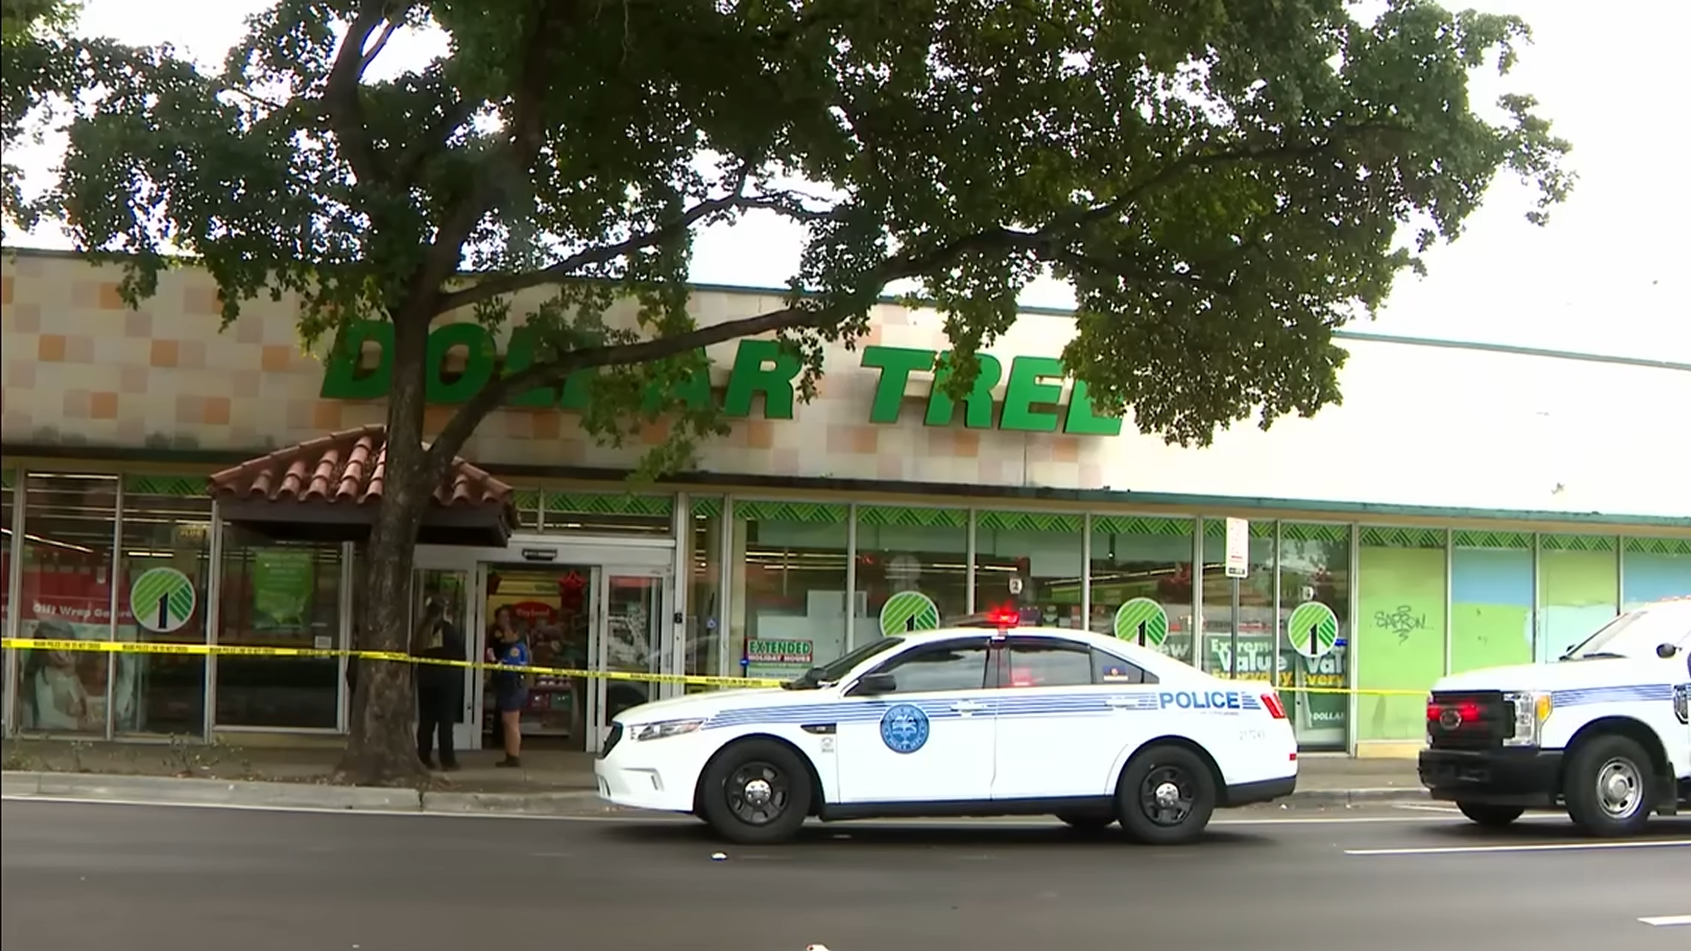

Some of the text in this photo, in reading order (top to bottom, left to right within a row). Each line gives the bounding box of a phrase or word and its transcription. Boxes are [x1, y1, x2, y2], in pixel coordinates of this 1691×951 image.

[749, 641, 810, 654] EXTENDED
[1211, 639, 1272, 652] Exrem
[748, 654, 811, 663] HOLIDAY HOURS
[1217, 651, 1288, 672] Value
[1305, 651, 1345, 674] Val
[1159, 691, 1241, 709] POLICE
